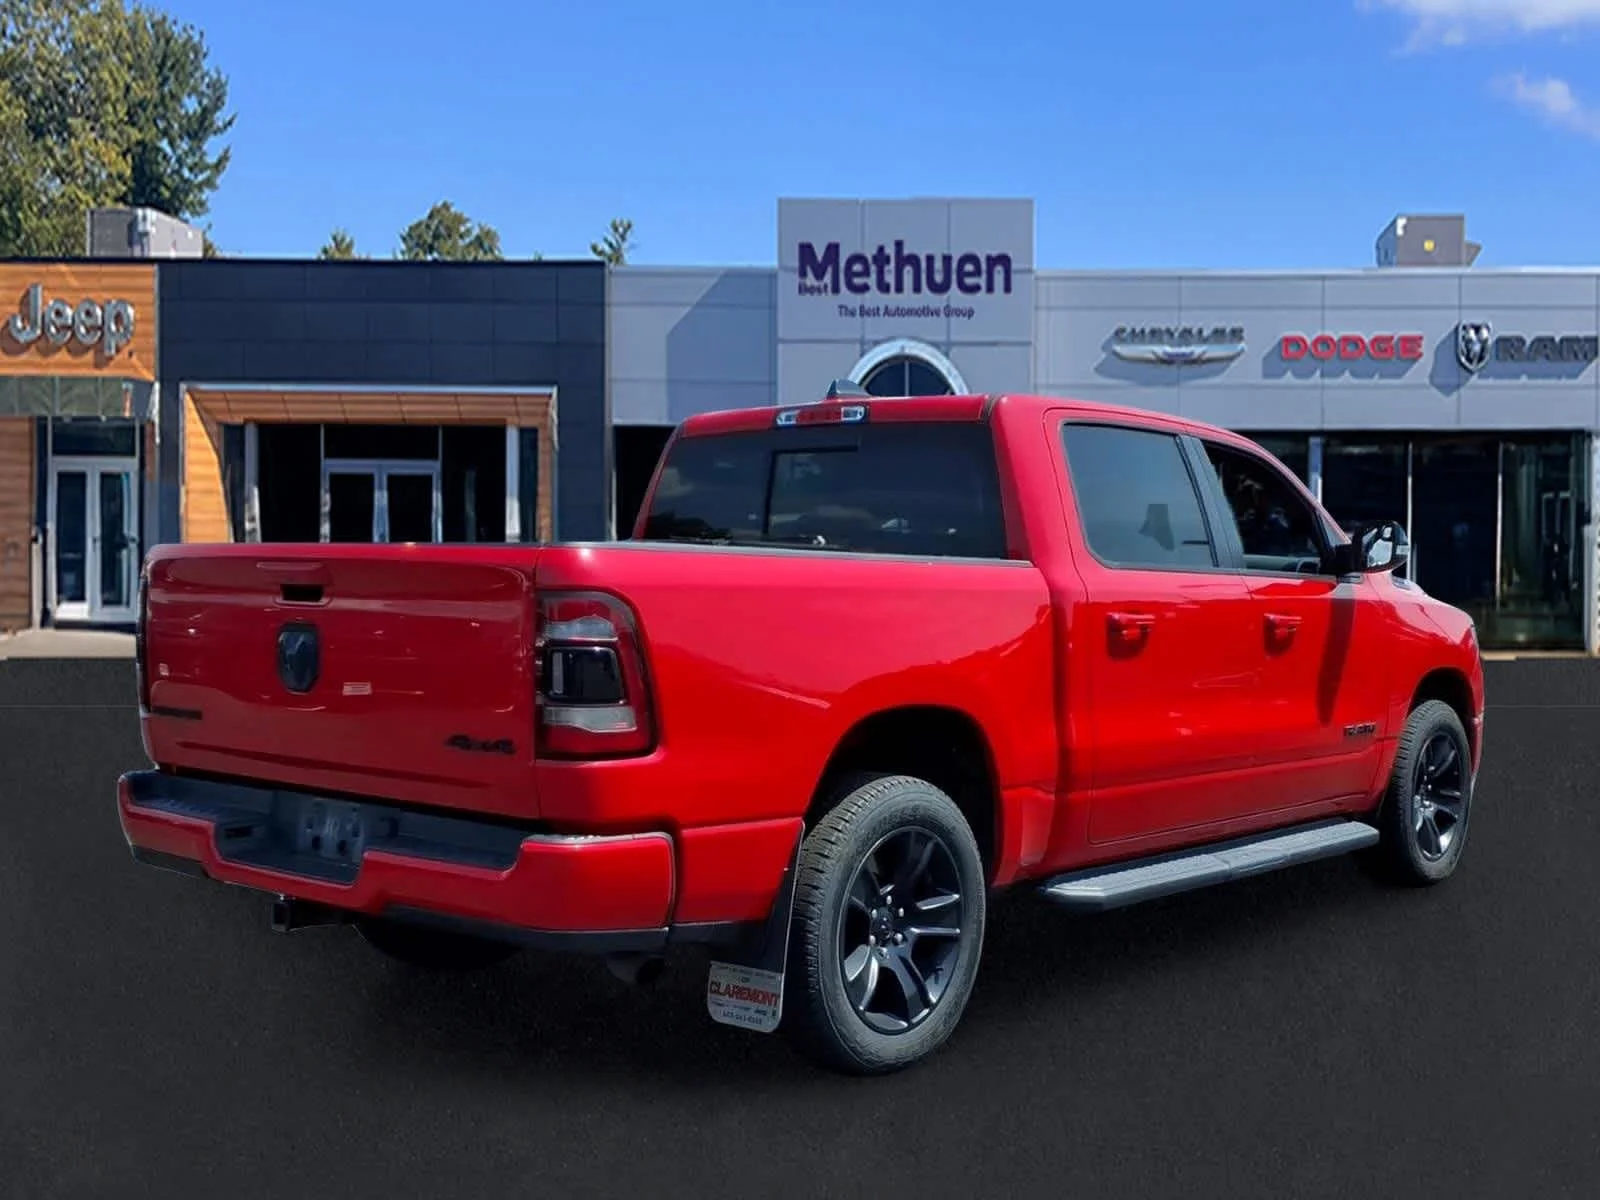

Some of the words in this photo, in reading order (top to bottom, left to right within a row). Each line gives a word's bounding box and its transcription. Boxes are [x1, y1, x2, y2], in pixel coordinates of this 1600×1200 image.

[798, 240, 1012, 295] Methuen
[798, 282, 830, 296] Best
[8, 283, 135, 356] Jeep
[838, 304, 857, 318] The
[859, 304, 881, 318] Best
[882, 304, 941, 318] Automotive
[943, 304, 975, 320] Group
[1114, 326, 1245, 343] CHRYSLER
[1281, 334, 1424, 360] DODGE
[1495, 334, 1599, 362] RAM
